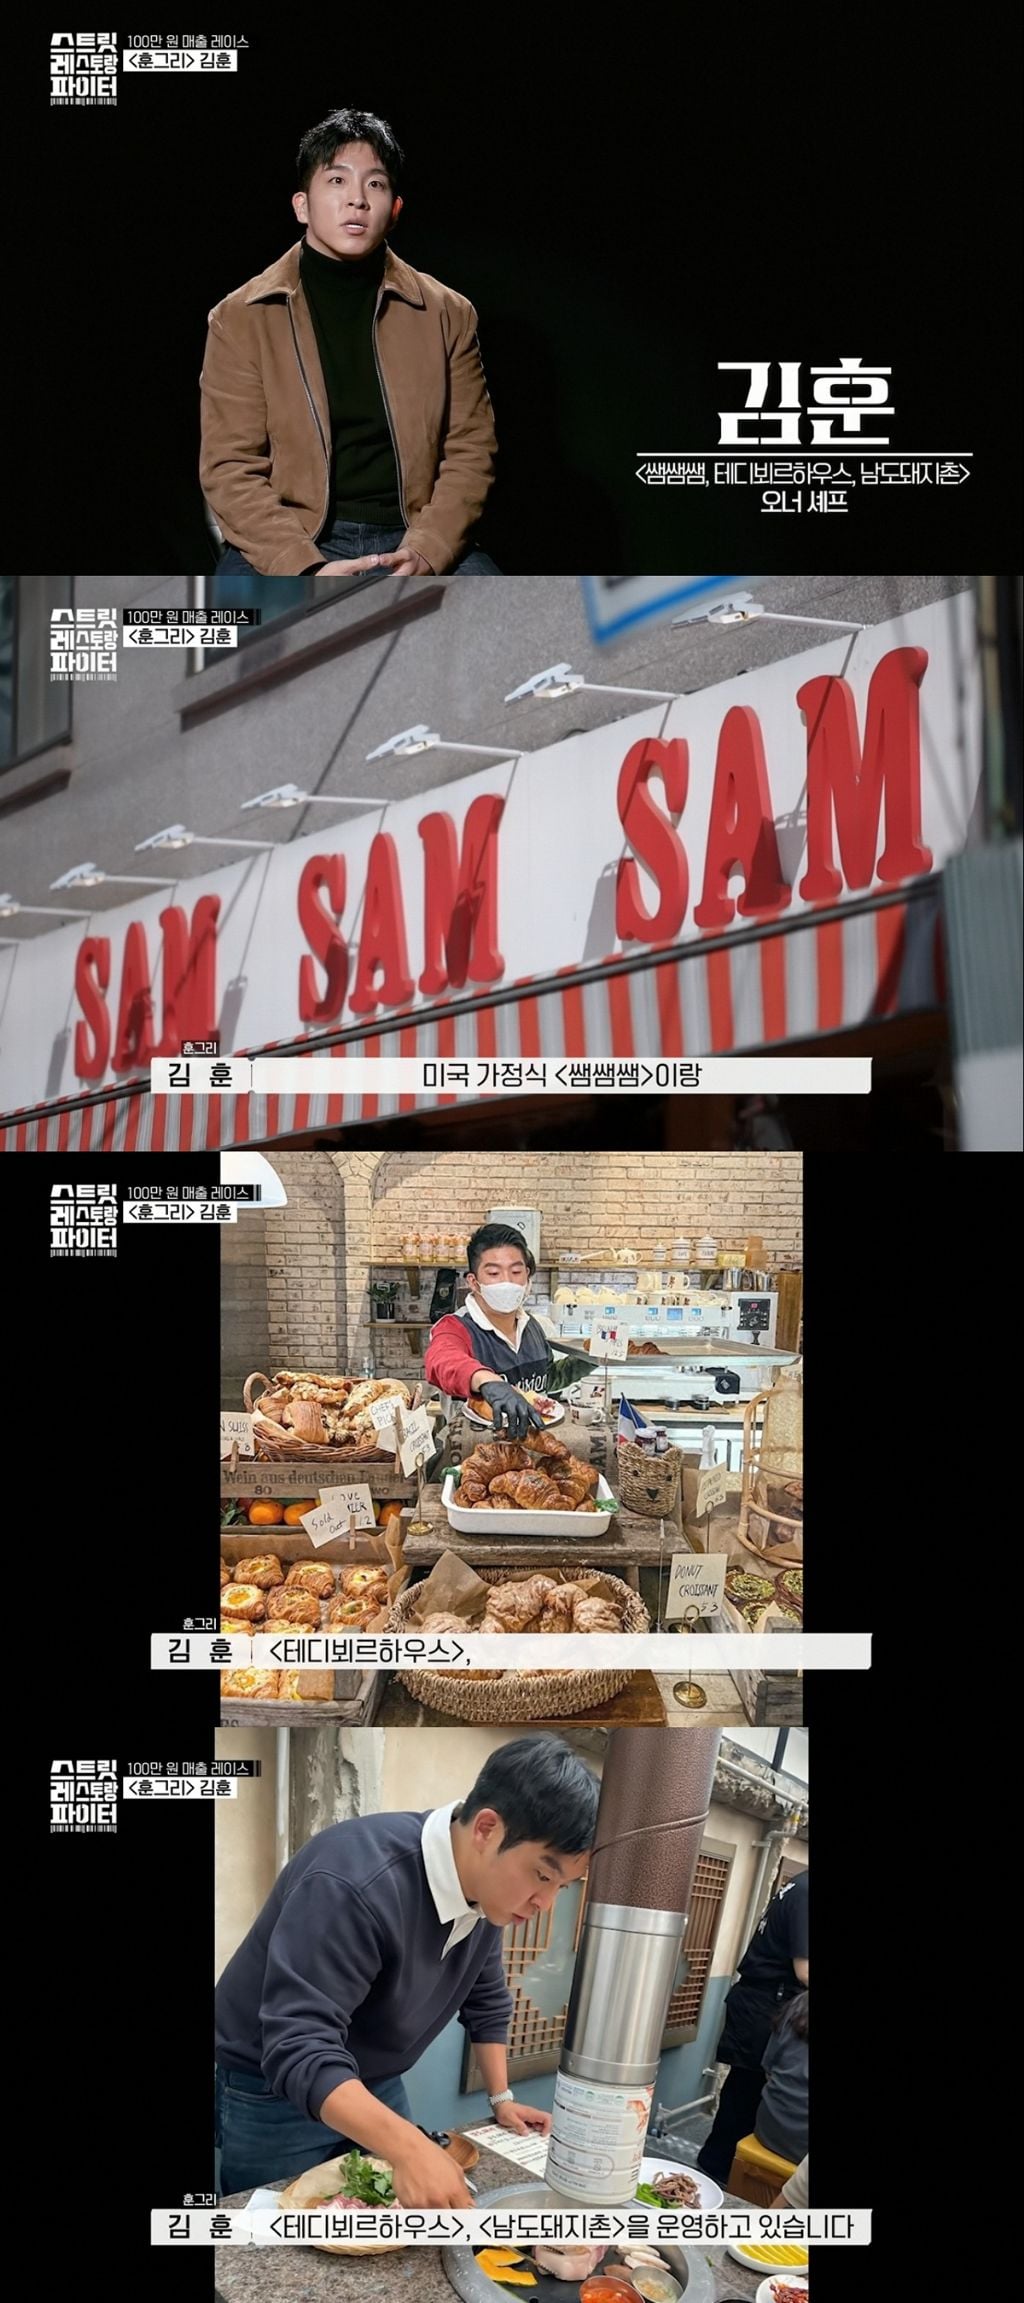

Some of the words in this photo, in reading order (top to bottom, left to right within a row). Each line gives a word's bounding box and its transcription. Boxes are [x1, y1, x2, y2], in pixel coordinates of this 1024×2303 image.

[74, 894, 221, 1080] SAM
[298, 794, 505, 1024] SAM
[616, 646, 934, 943] SAM
